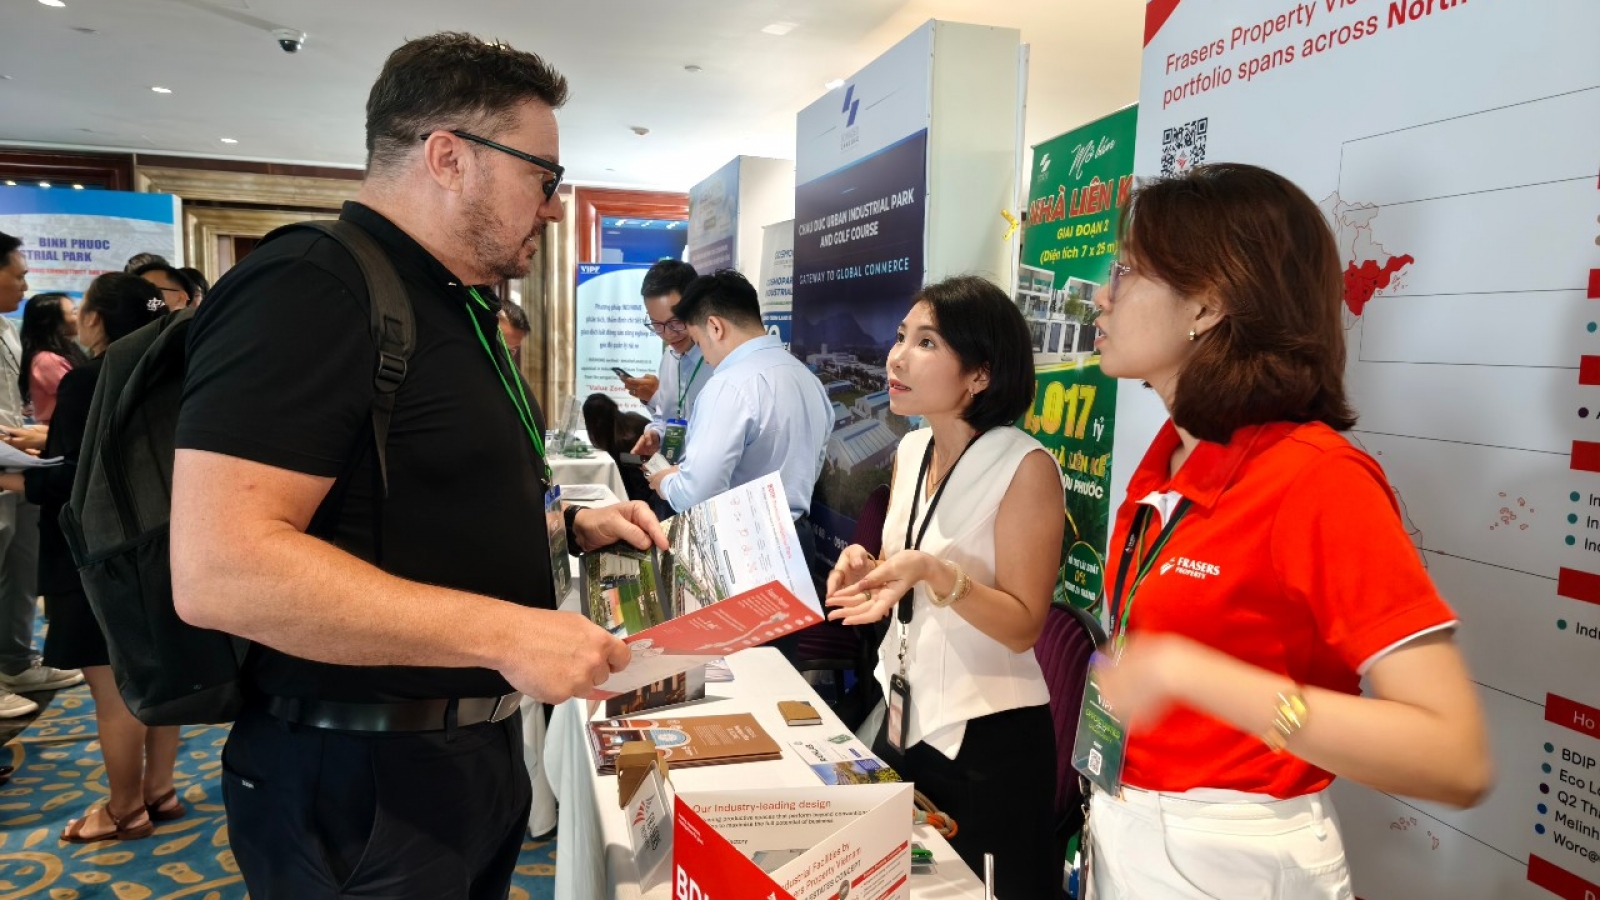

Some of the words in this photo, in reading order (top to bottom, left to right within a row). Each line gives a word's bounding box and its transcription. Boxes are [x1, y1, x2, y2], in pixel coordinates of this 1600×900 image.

[1165, 38, 1225, 76] Frasers
[1230, 0, 1317, 51] Property
[1163, 65, 1232, 110] portfolio
[1238, 45, 1295, 82] spans
[1302, 15, 1378, 58] across
[1387, 0, 1467, 30] Nor
[1069, 175, 1114, 218] LIÊN
[826, 209, 847, 229] URBAN
[849, 197, 890, 221] INDUSTRIAL
[891, 187, 915, 210] PARK
[820, 233, 833, 248] AND
[834, 228, 851, 245] GOLF
[851, 220, 879, 240] COURSE
[1057, 226, 1073, 240] GIAI
[1075, 220, 1102, 238] ĐOẠN
[1103, 219, 1110, 232] 2
[39, 237, 67, 248] BINH
[71, 239, 110, 250] PHUOC
[1081, 244, 1088, 258] 7
[1088, 246, 1095, 257] x
[62, 251, 92, 262] PARK
[799, 271, 825, 285] GATEWAY
[826, 270, 835, 281] TO
[836, 265, 862, 280] GLOBAL
[864, 257, 910, 276] COMMERCE
[1174, 566, 1206, 580] PROPERTY
[1177, 556, 1220, 576] FRASERS
[1576, 621, 1600, 640] Ind
[1573, 710, 1596, 730] Ho
[1561, 747, 1597, 770] BDIP
[1559, 768, 1586, 789] Eco
[693, 804, 712, 814] Our
[714, 801, 797, 813] Industry-leading
[798, 799, 832, 810] design
[1557, 790, 1577, 809] Q2
[1554, 810, 1600, 841] Melinh
[675, 864, 710, 900] BD
